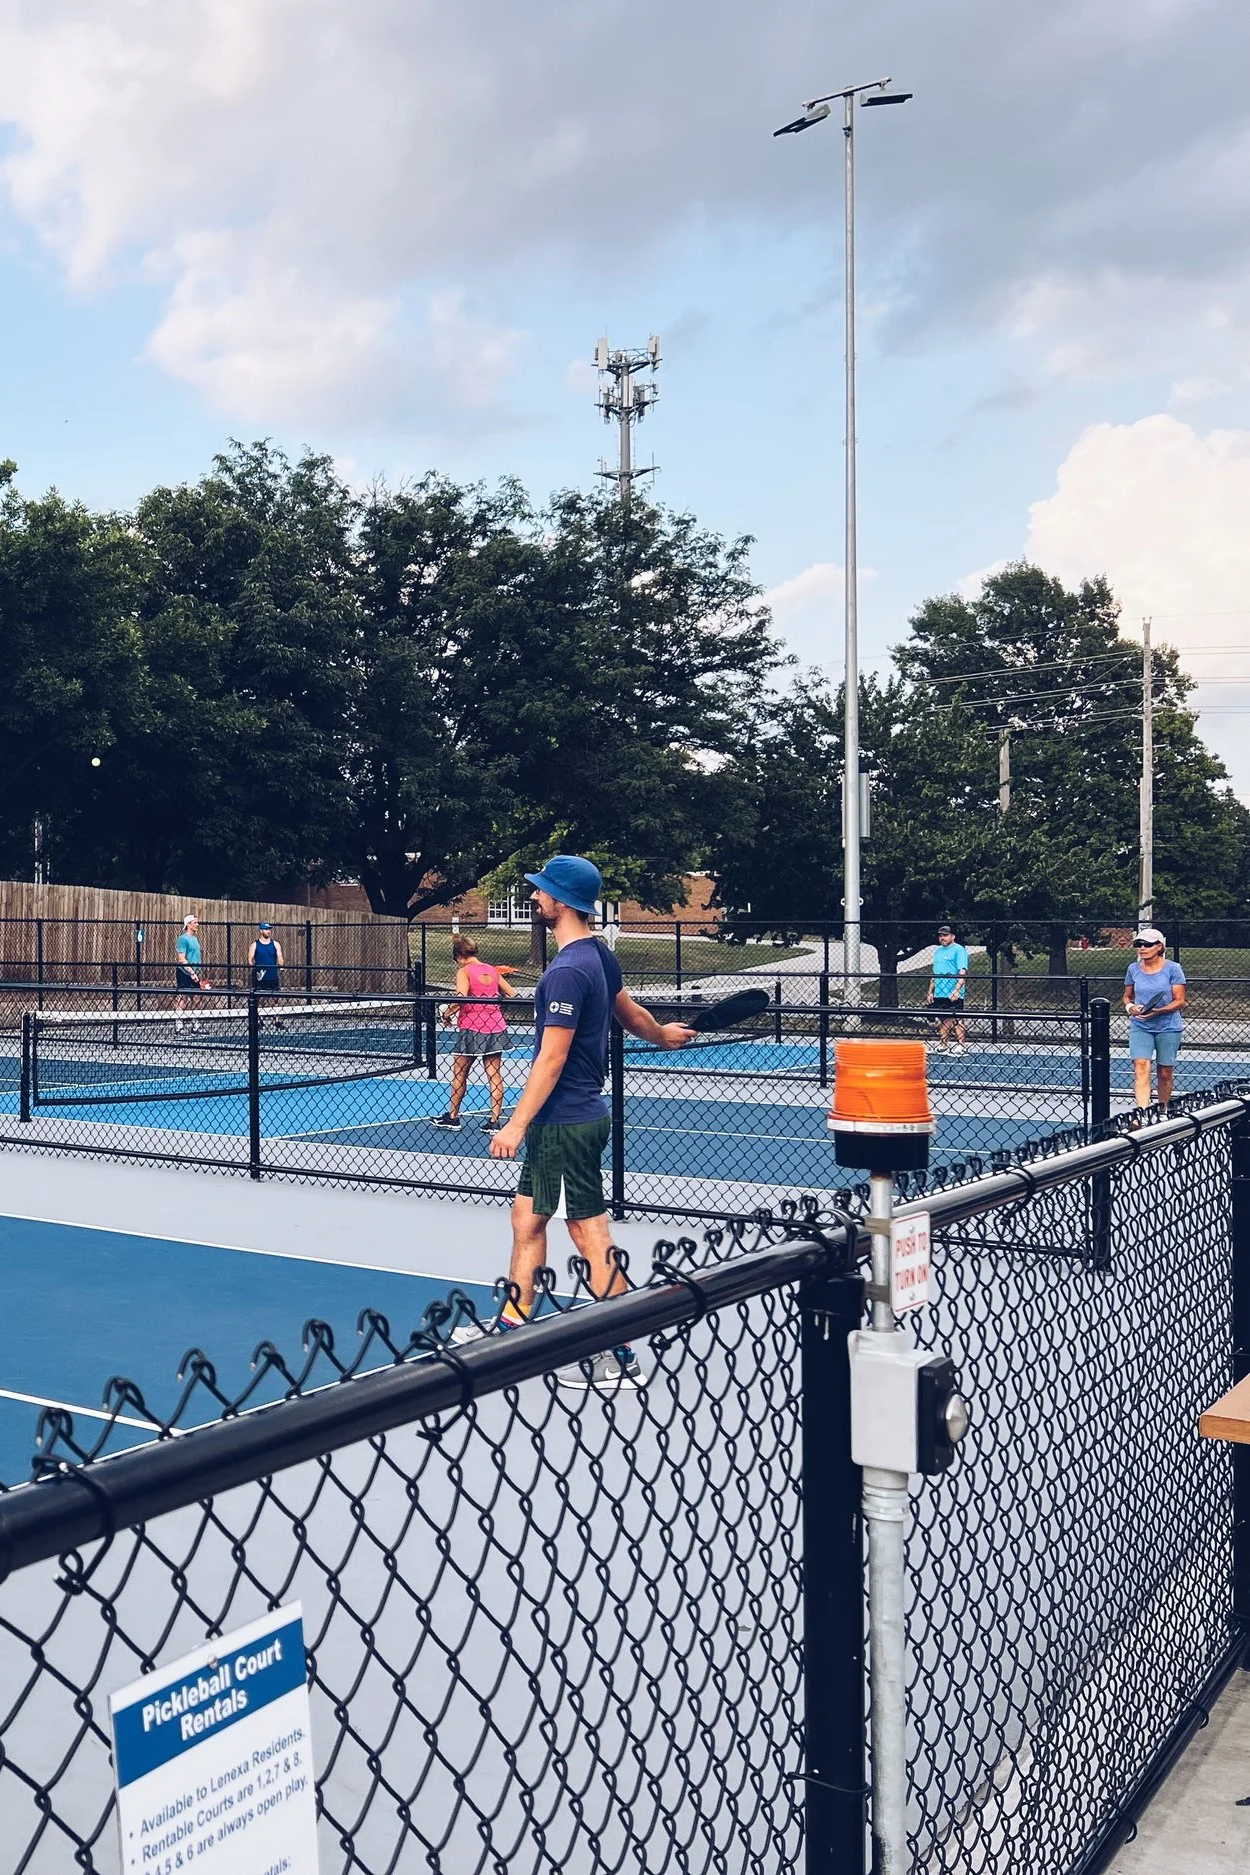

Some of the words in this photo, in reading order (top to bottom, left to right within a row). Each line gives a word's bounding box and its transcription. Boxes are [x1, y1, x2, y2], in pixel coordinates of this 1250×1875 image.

[137, 927, 143, 943] 6
[895, 1234, 916, 1259] PUSH
[918, 1231, 927, 1252] TO
[895, 1266, 916, 1292] TURN
[917, 1263, 928, 1285] ON
[142, 1664, 231, 1732] Pickleball
[234, 1638, 282, 1681] Court
[180, 1688, 248, 1741] Rentals
[140, 1793, 193, 1837] Available
[196, 1786, 208, 1802] to
[210, 1761, 250, 1793] Lenexa
[252, 1727, 306, 1766] Residents.
[142, 1820, 194, 1863] Rentable
[197, 1794, 234, 1827] Courts
[237, 1783, 254, 1804] are
[257, 1763, 280, 1790] 1,2,7
[283, 1757, 291, 1774] &
[175, 1851, 184, 1869] &
[187, 1844, 194, 1861] 6
[197, 1834, 214, 1855] are
[217, 1808, 254, 1842] always
[257, 1789, 283, 1817] open
[285, 1774, 308, 1802] play.
